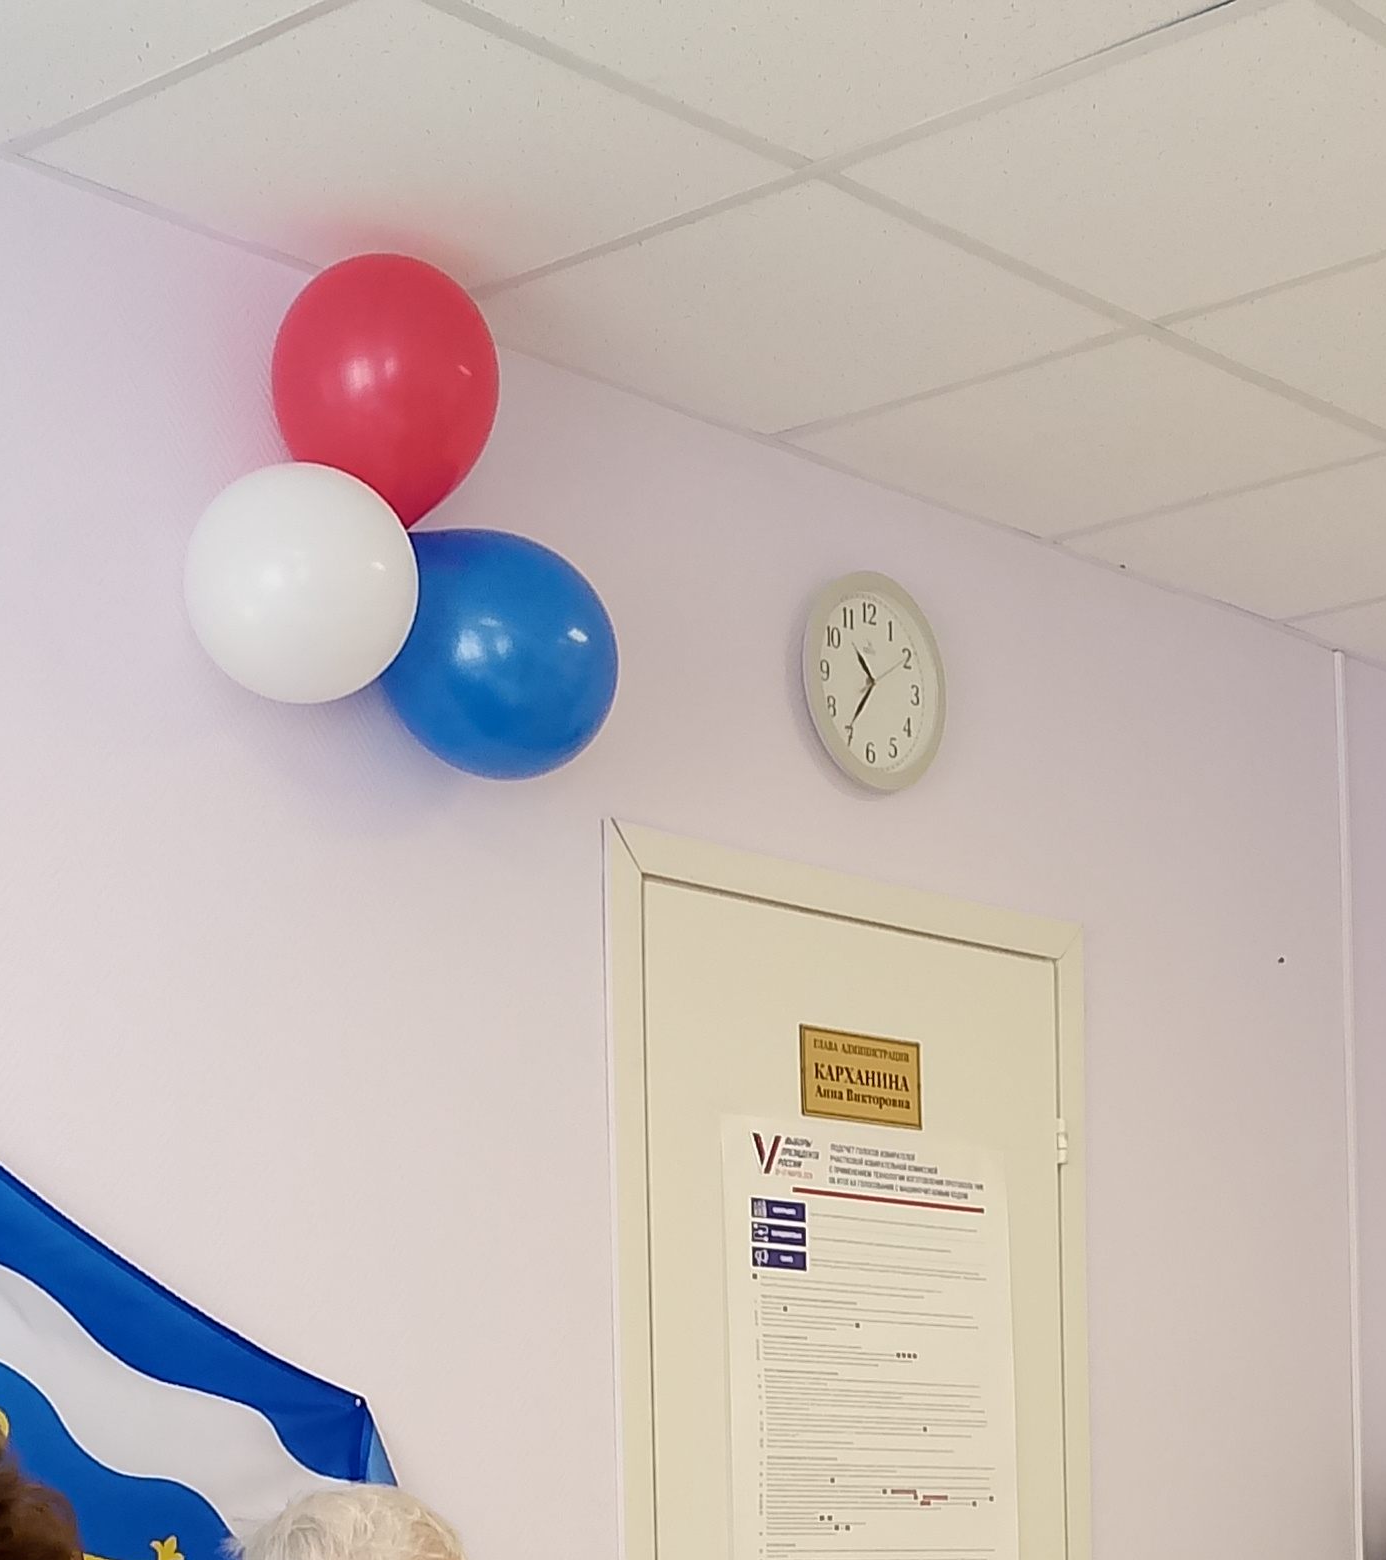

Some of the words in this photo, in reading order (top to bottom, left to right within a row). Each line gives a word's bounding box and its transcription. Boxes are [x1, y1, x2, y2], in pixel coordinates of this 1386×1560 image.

[842, 606, 854, 630] 11
[862, 602, 877, 626] 12
[826, 626, 841, 649] 10
[888, 620, 893, 642] 1
[902, 648, 912, 669] 2
[820, 660, 830, 681] 9
[827, 695, 836, 717] 8
[910, 685, 920, 706] 3
[844, 725, 853, 747] 7
[903, 717, 912, 737] 4
[865, 742, 876, 764] 6
[888, 738, 898, 758] 5
[814, 1062, 910, 1092] КАРХАНИНА
[815, 1084, 843, 1101] Анна
[846, 1088, 911, 1110] Викторовна
